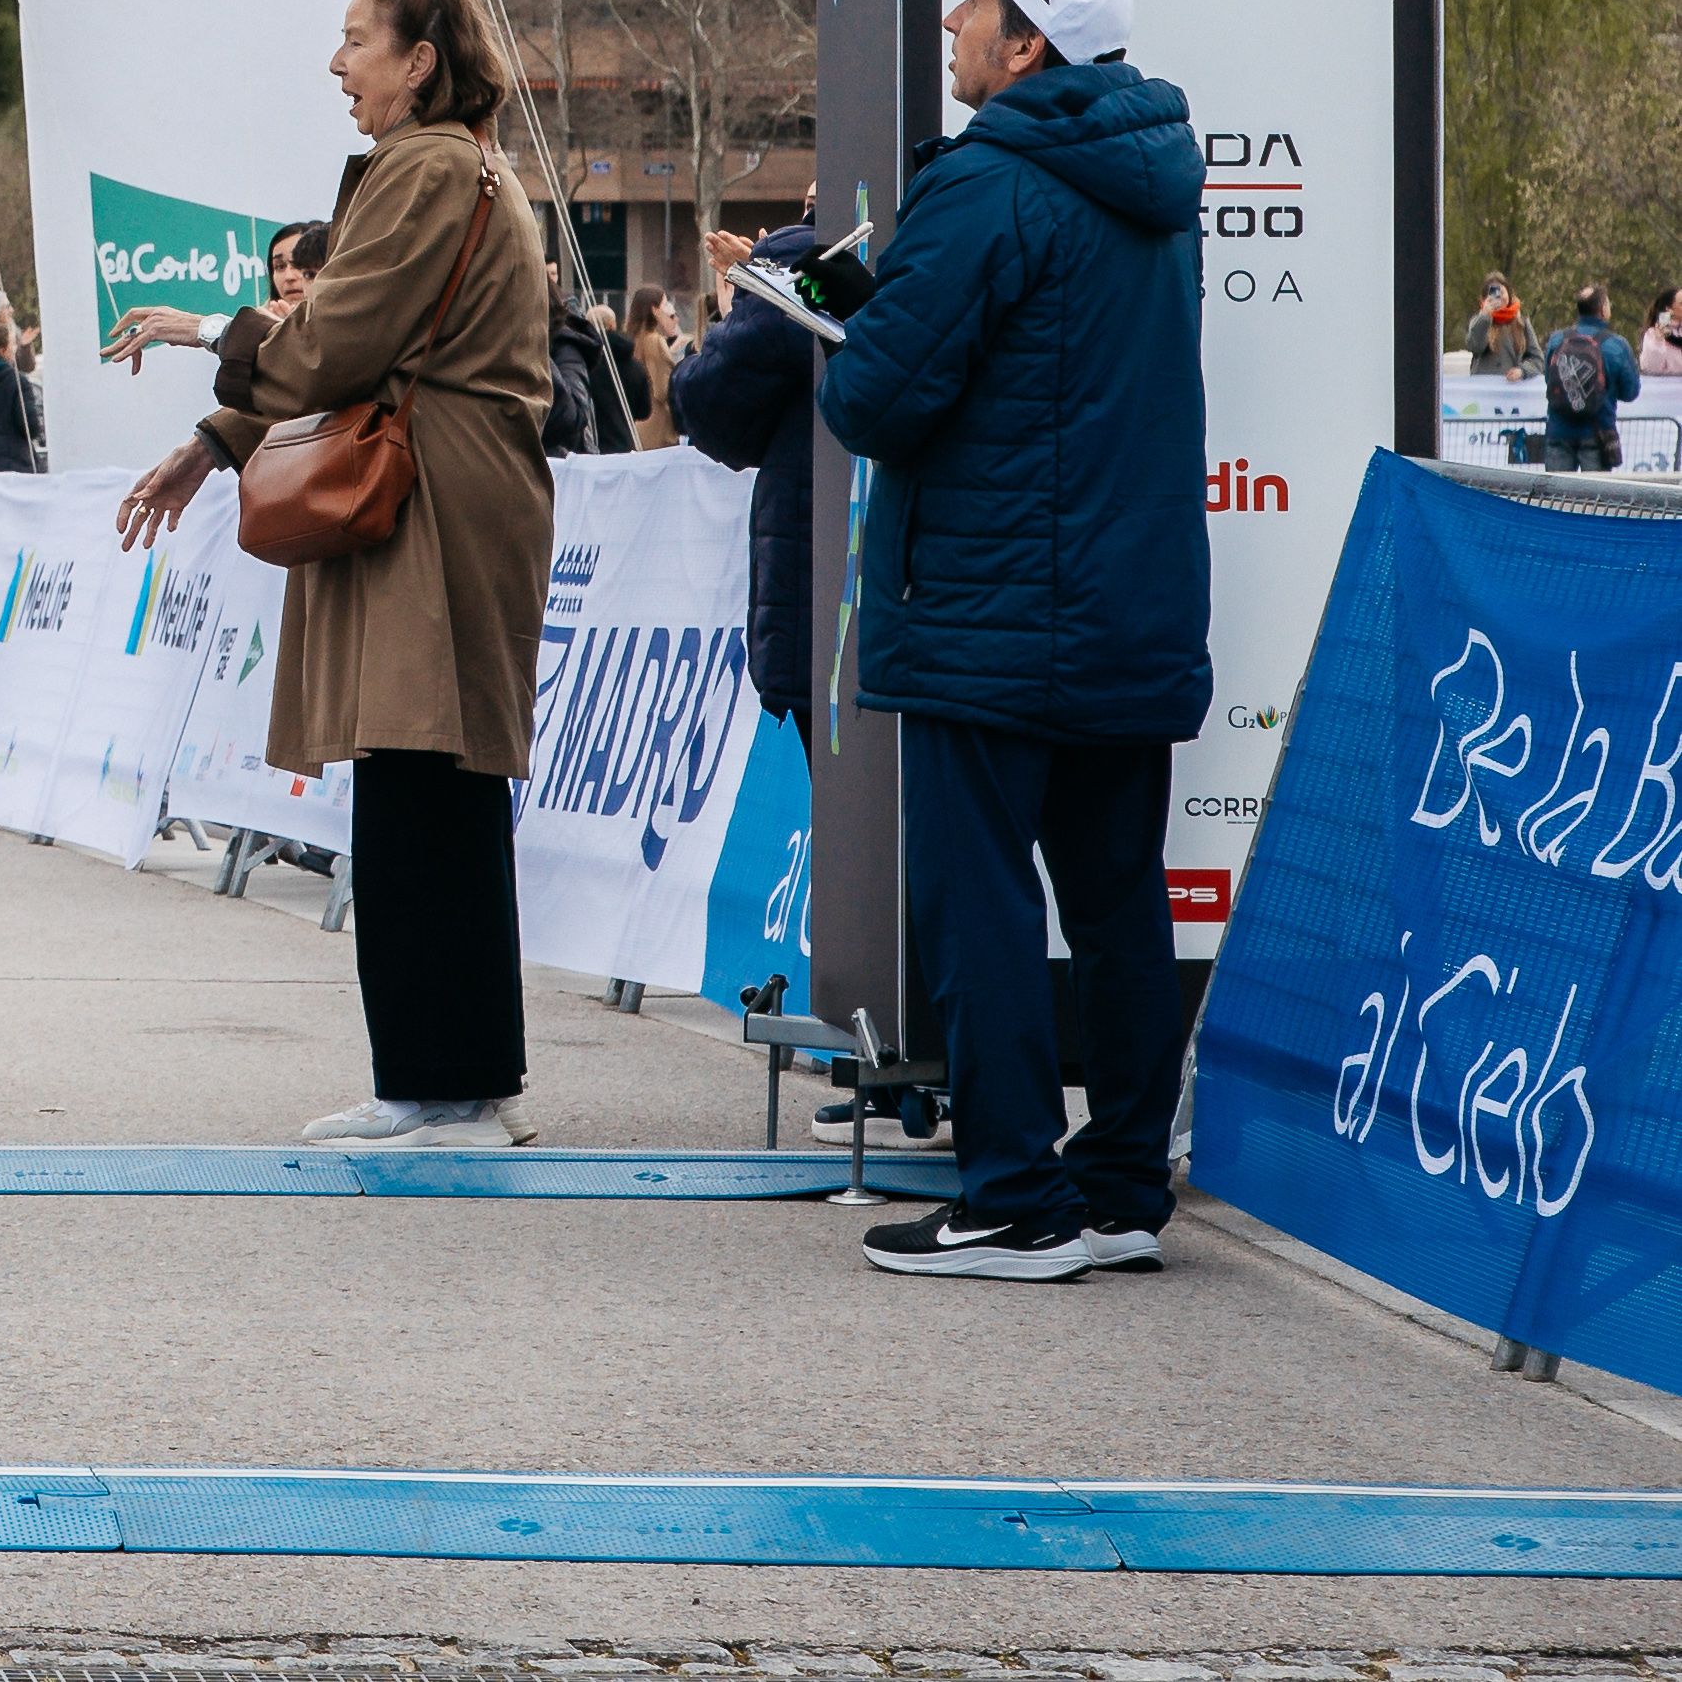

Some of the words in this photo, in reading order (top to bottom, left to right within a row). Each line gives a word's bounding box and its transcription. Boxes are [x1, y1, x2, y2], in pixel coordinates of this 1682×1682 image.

[98, 242, 131, 284] El
[131, 242, 219, 284] Corte
[18, 550, 74, 632] MetLife
[152, 568, 212, 655] MetLife
[538, 626, 746, 873] MADRID
[1411, 627, 1535, 848] De
[1516, 650, 1610, 867] la
[1184, 797, 1266, 817] CORR
[1333, 930, 1413, 1144] al
[1412, 954, 1596, 1217] Cielo
